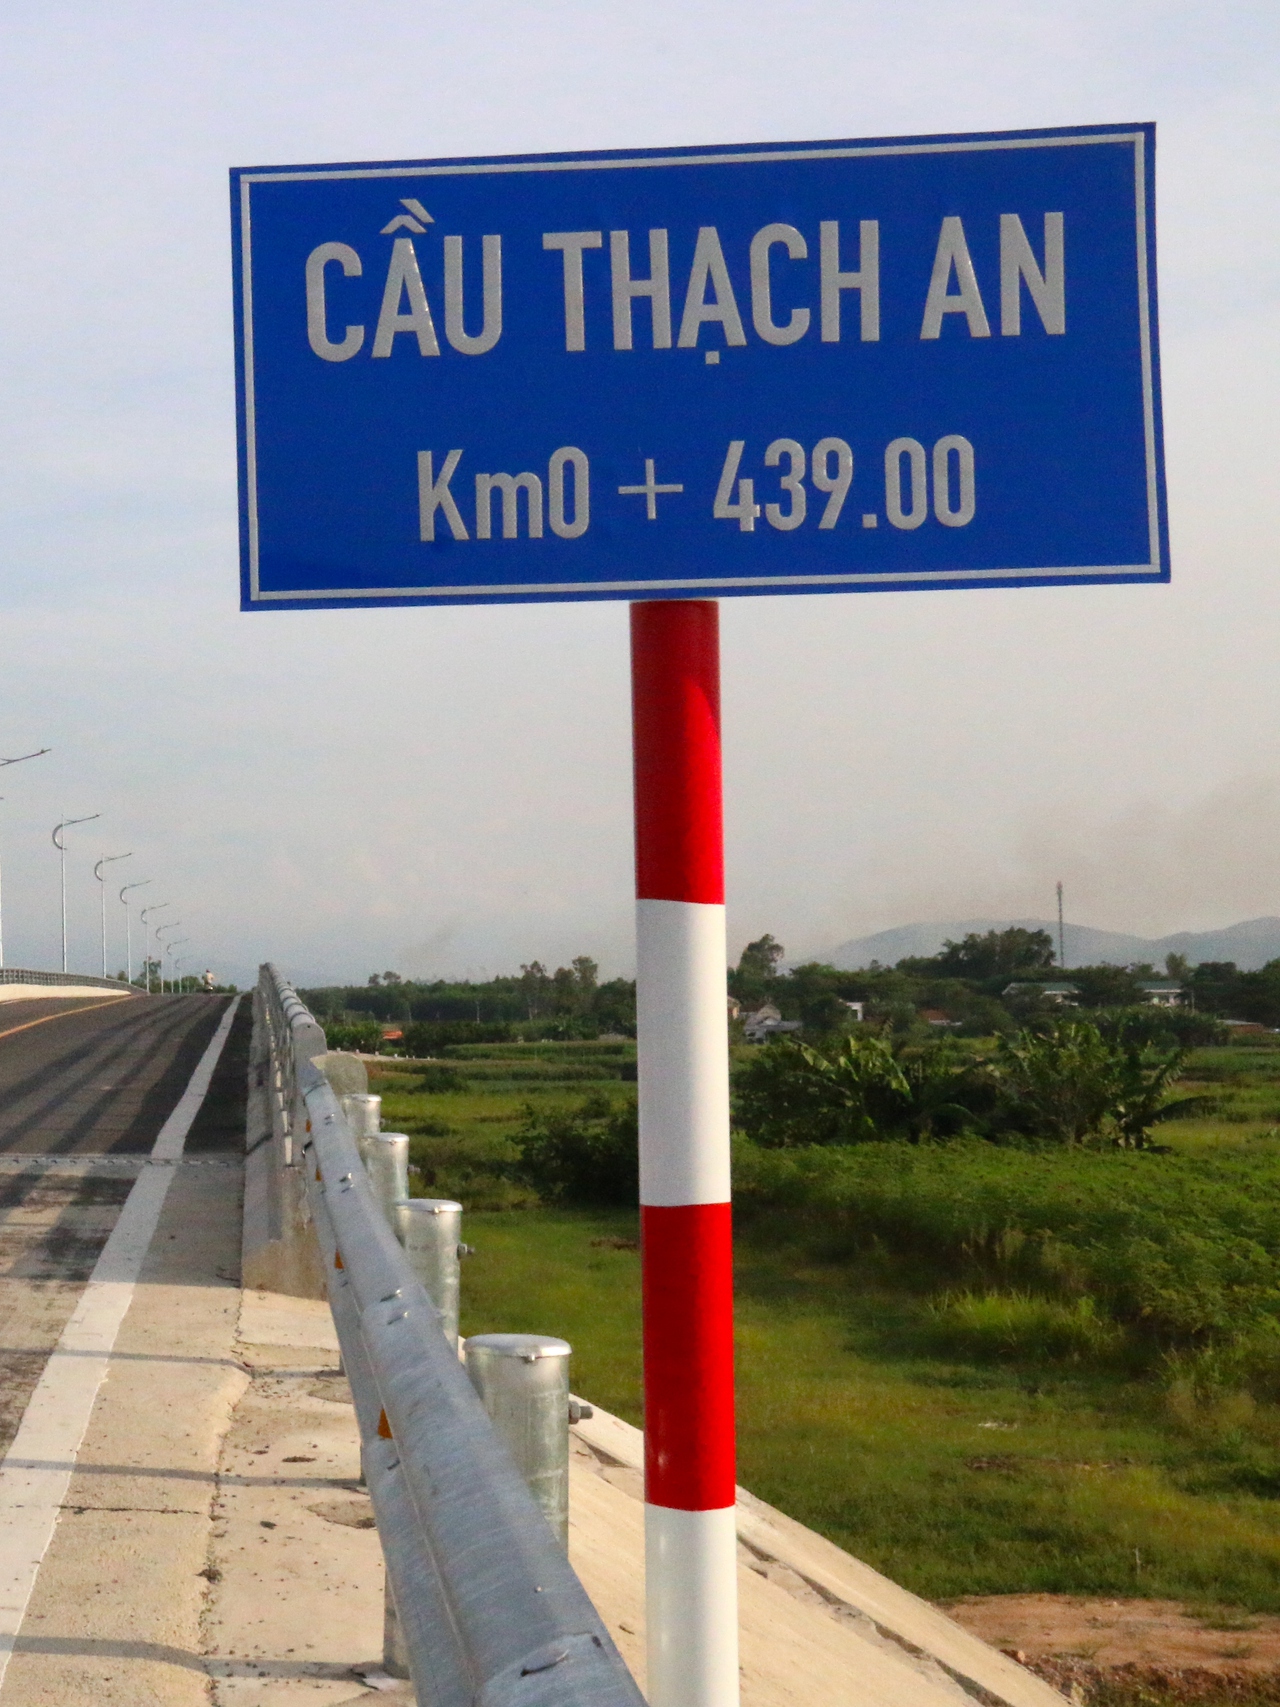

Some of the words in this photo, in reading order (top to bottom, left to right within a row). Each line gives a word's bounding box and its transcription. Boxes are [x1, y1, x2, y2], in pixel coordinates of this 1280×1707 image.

[305, 198, 503, 362] CẦU
[543, 220, 881, 365] THẠCH
[919, 211, 1066, 338] AN
[418, 446, 590, 542] Km0
[618, 459, 683, 520] +
[713, 434, 976, 533] 439.00
